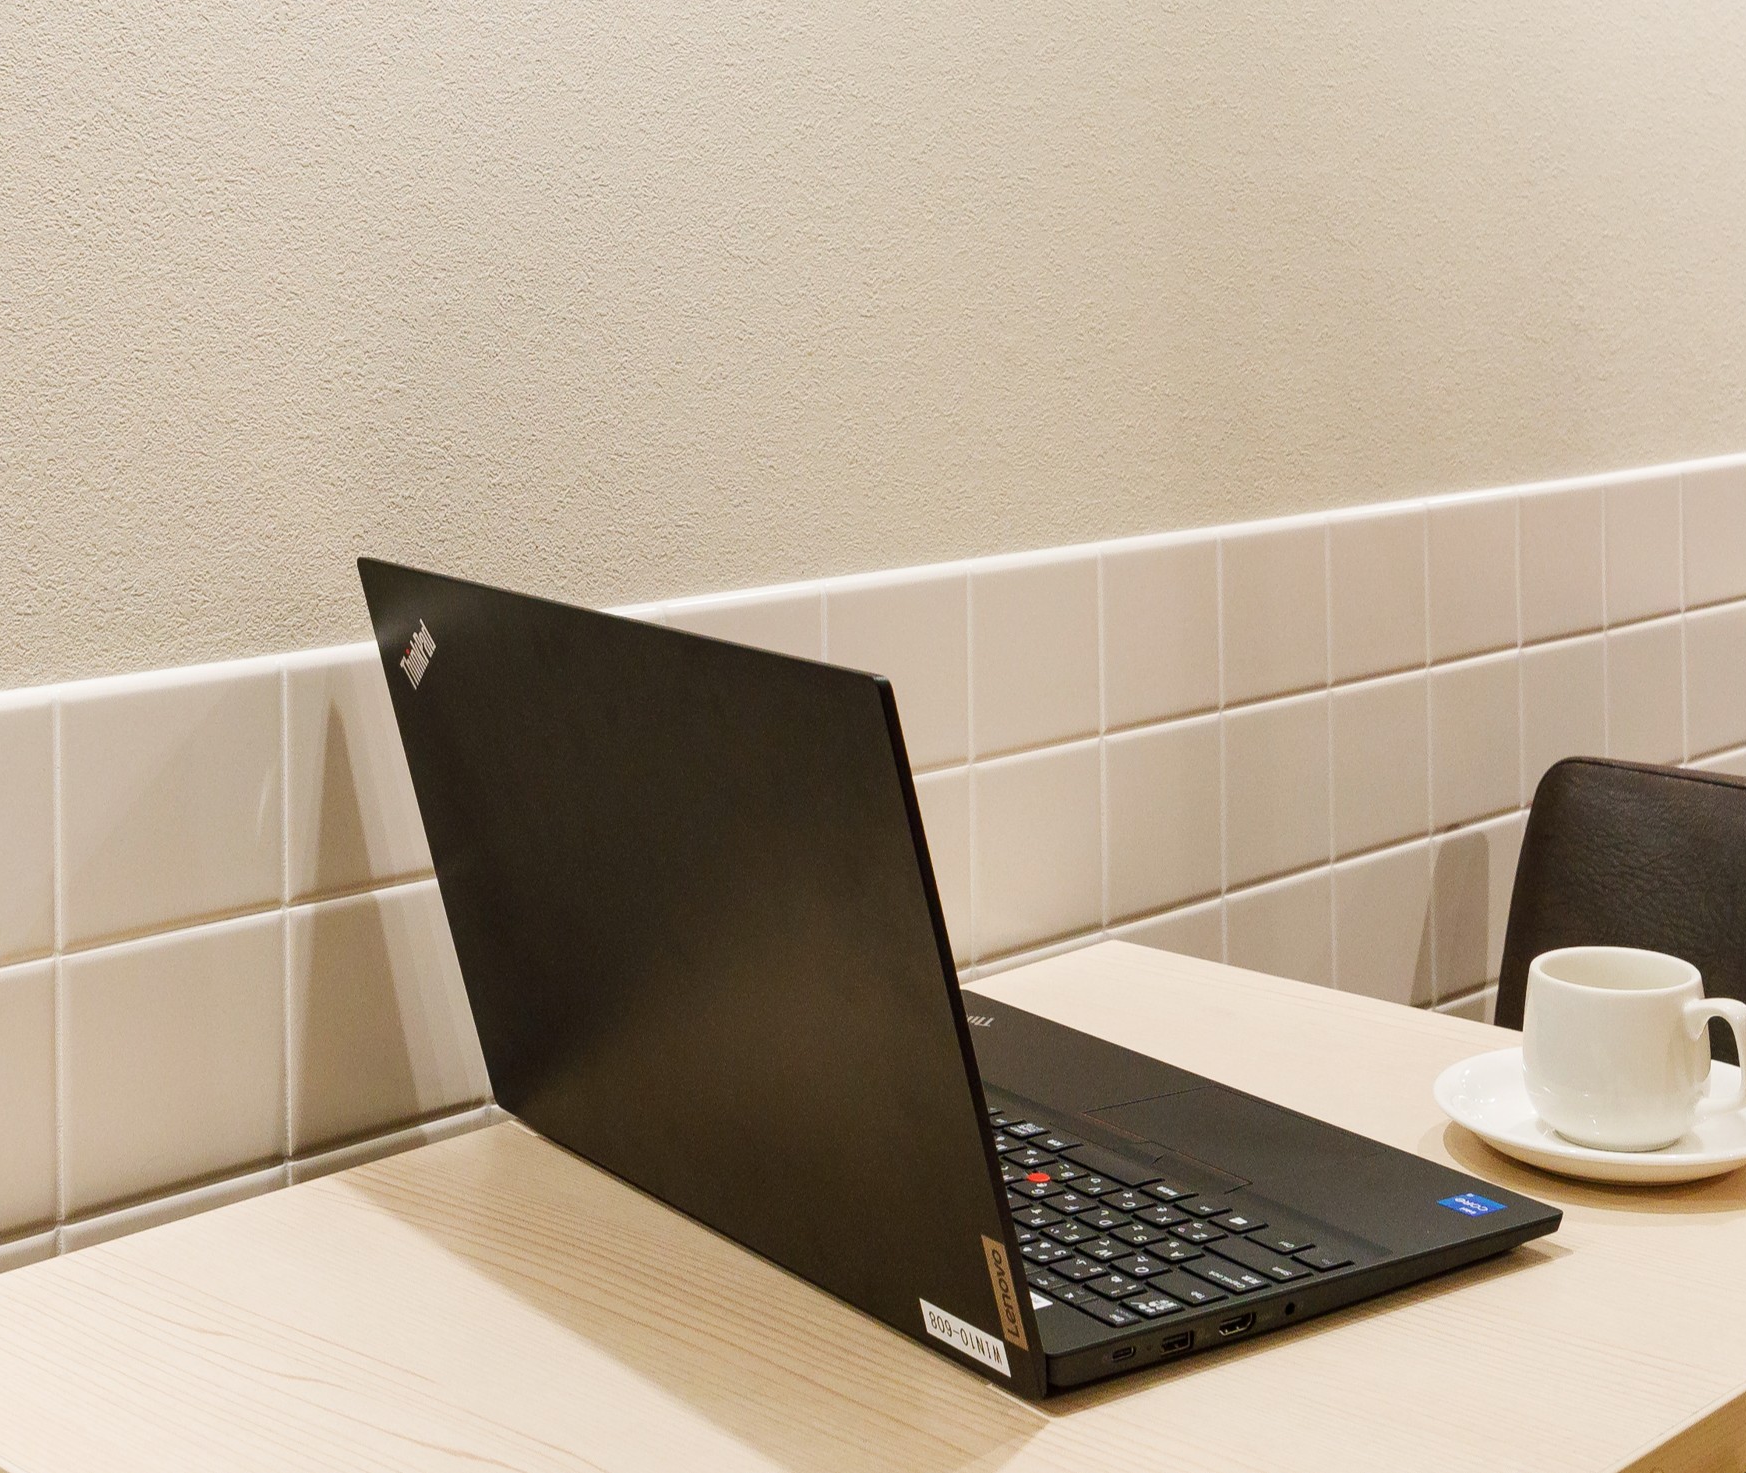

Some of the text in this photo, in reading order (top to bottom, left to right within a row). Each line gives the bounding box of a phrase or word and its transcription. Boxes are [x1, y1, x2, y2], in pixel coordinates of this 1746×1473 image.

[399, 618, 437, 690] ThinkPad
[991, 1249, 1020, 1338] Lenovo
[928, 1311, 1003, 1365] WIN10-608
